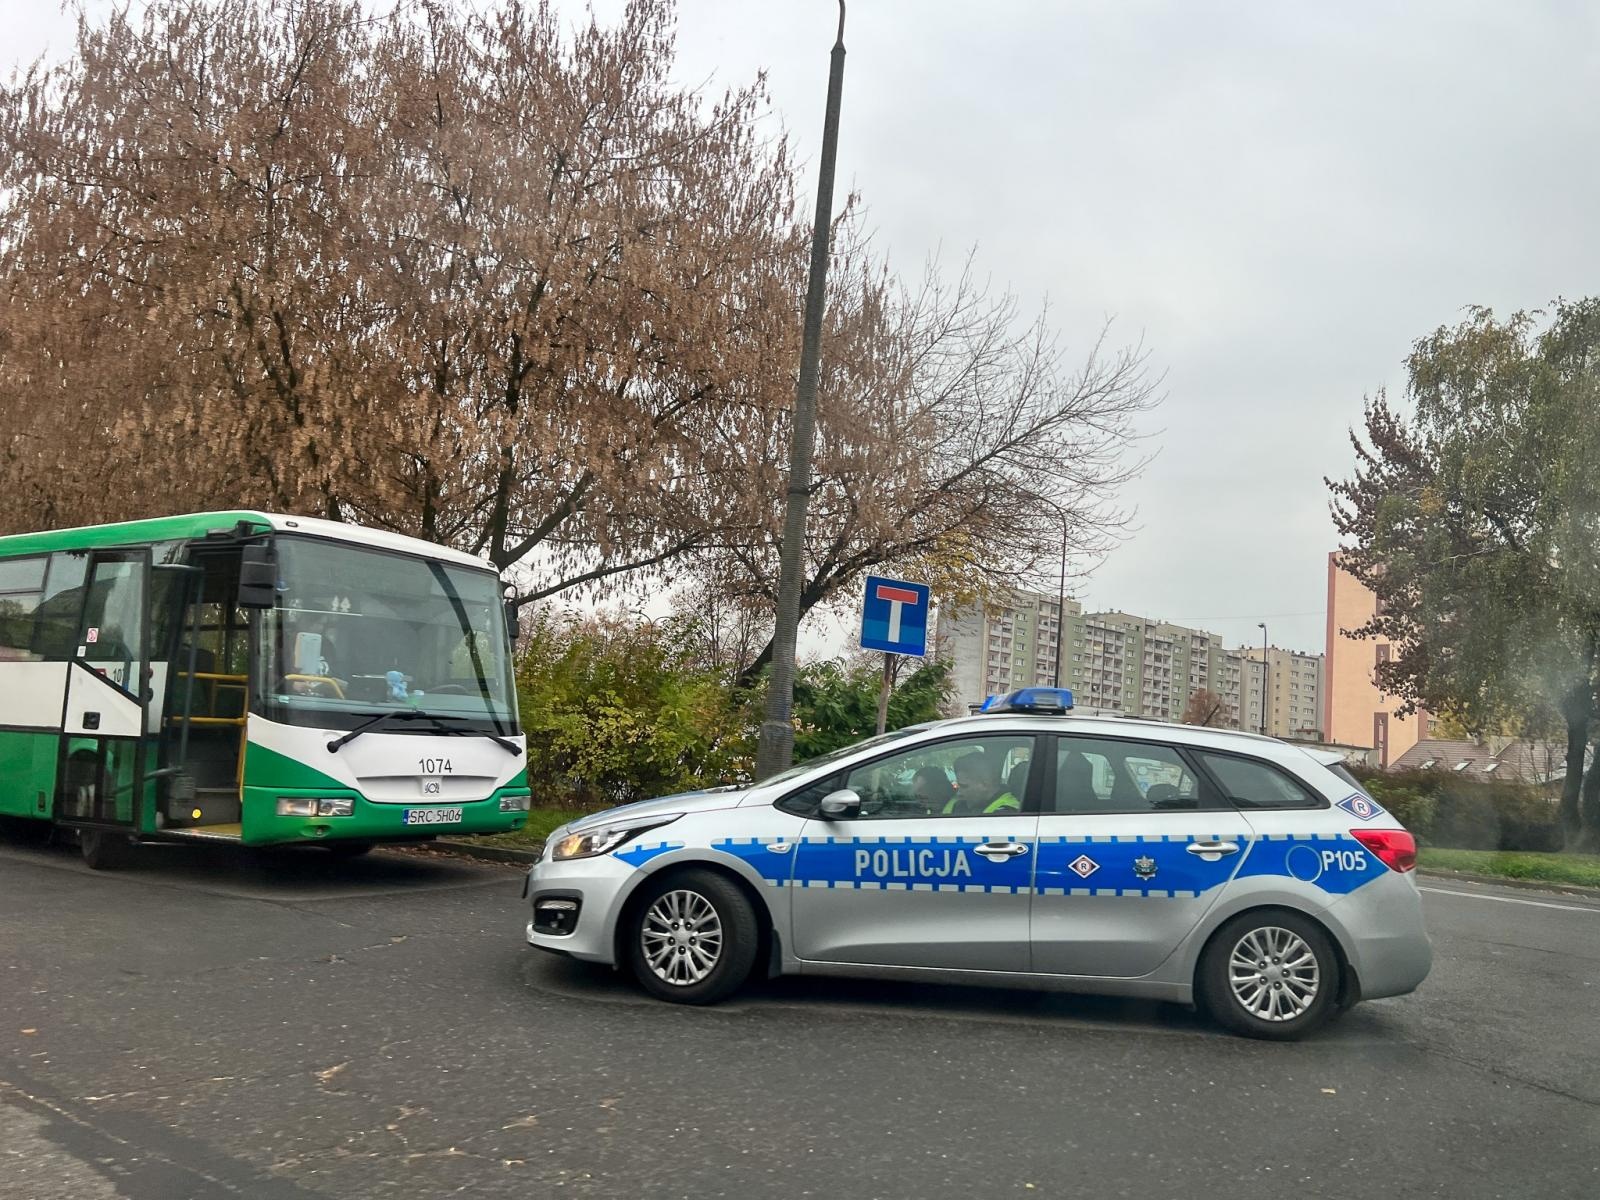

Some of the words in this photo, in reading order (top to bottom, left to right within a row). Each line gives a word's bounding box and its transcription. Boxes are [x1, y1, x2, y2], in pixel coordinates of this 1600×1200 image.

[419, 758, 452, 773] 1074
[410, 810, 433, 824] SRC
[855, 849, 972, 877] POLICJA
[1321, 850, 1368, 872] P105
